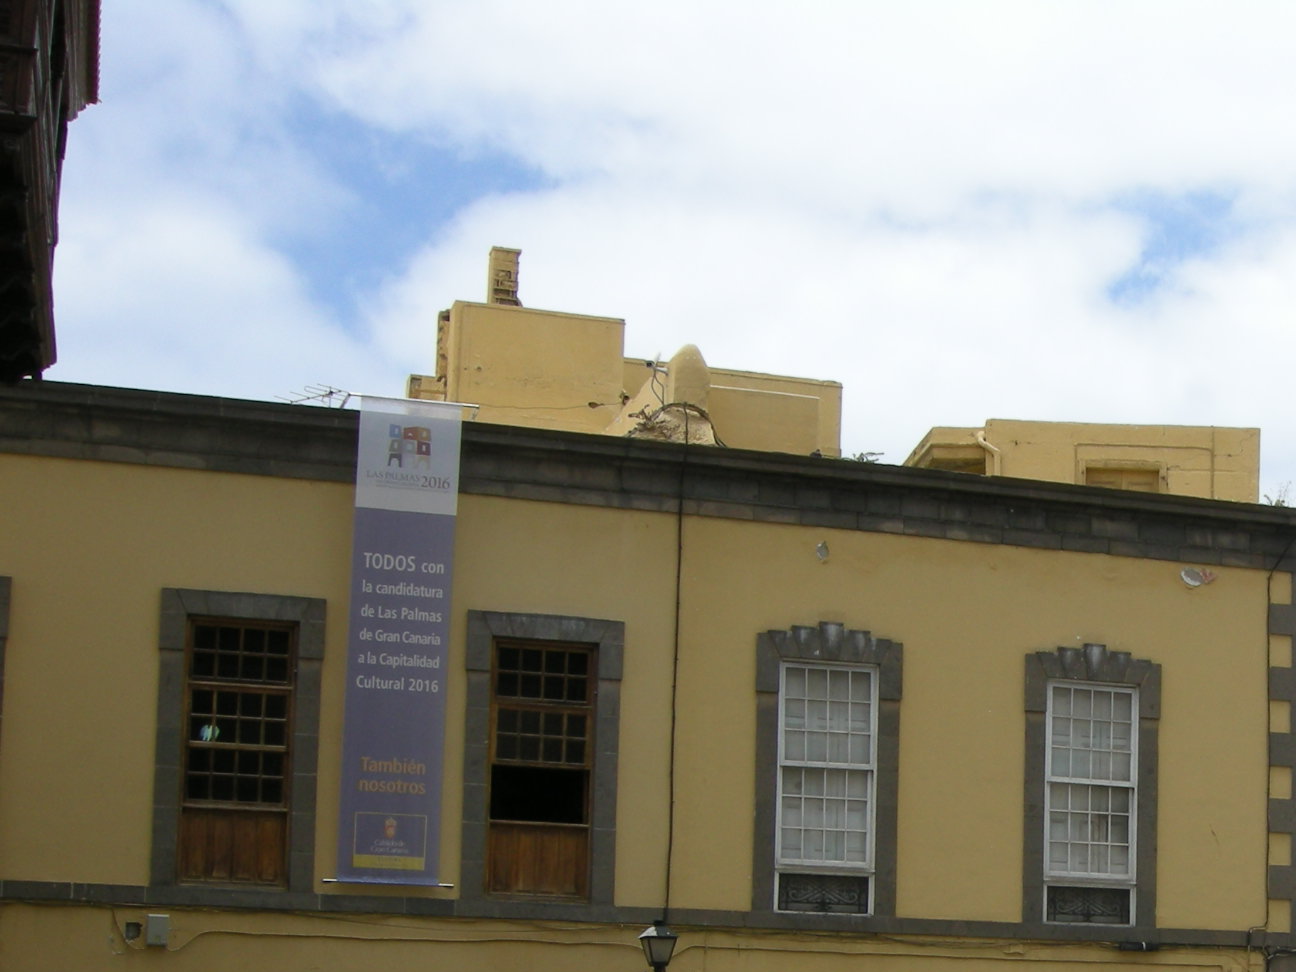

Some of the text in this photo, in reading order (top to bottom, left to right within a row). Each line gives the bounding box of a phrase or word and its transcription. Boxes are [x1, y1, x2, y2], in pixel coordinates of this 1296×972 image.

[421, 476, 450, 490] 2016
[363, 552, 445, 574] TODOS con
[362, 579, 443, 598] la candidatura
[360, 604, 442, 623] de Las Palmas
[359, 627, 440, 645] de Gran Canaria
[358, 651, 440, 669] a la Capitalidad
[356, 675, 439, 693] Cultural 2016
[361, 757, 426, 775] También
[359, 779, 426, 795] nosotros
